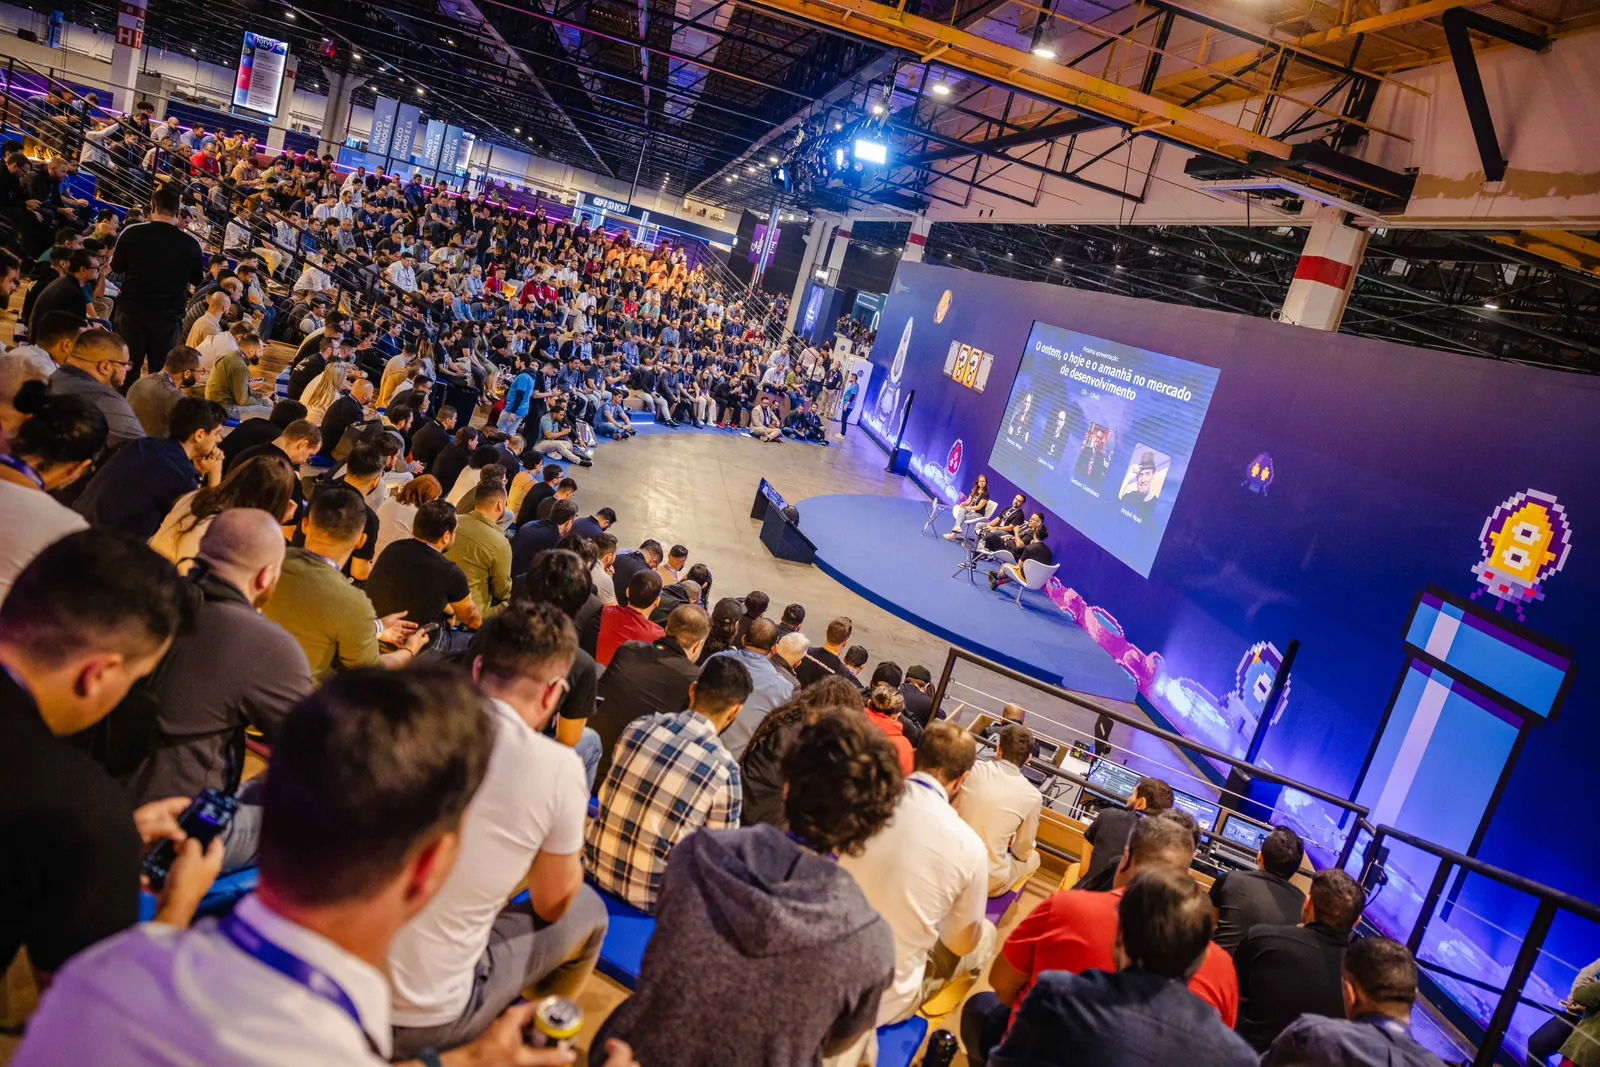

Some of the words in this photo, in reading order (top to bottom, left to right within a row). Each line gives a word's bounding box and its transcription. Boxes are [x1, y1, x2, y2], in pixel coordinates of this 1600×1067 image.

[373, 121, 383, 145] PALCO
[378, 129, 390, 154] DADOS
[393, 127, 404, 151] PALCO
[399, 134, 411, 160] DADOS
[424, 138, 434, 159] PALCO
[429, 145, 440, 166] DADOS
[442, 143, 451, 164] PALCO
[446, 149, 456, 171] DADOS
[1035, 340, 1042, 351] O
[1041, 344, 1062, 361] ontem,
[1063, 351, 1069, 361] o
[1068, 350, 1085, 368] hoje
[1085, 359, 1092, 369] e
[1091, 361, 1098, 371] o
[1097, 362, 1133, 382] amanhã
[1132, 374, 1146, 387] no
[1146, 378, 1192, 402] mercado
[1060, 363, 1070, 376] de
[1069, 367, 1137, 401] desenvolvimento
